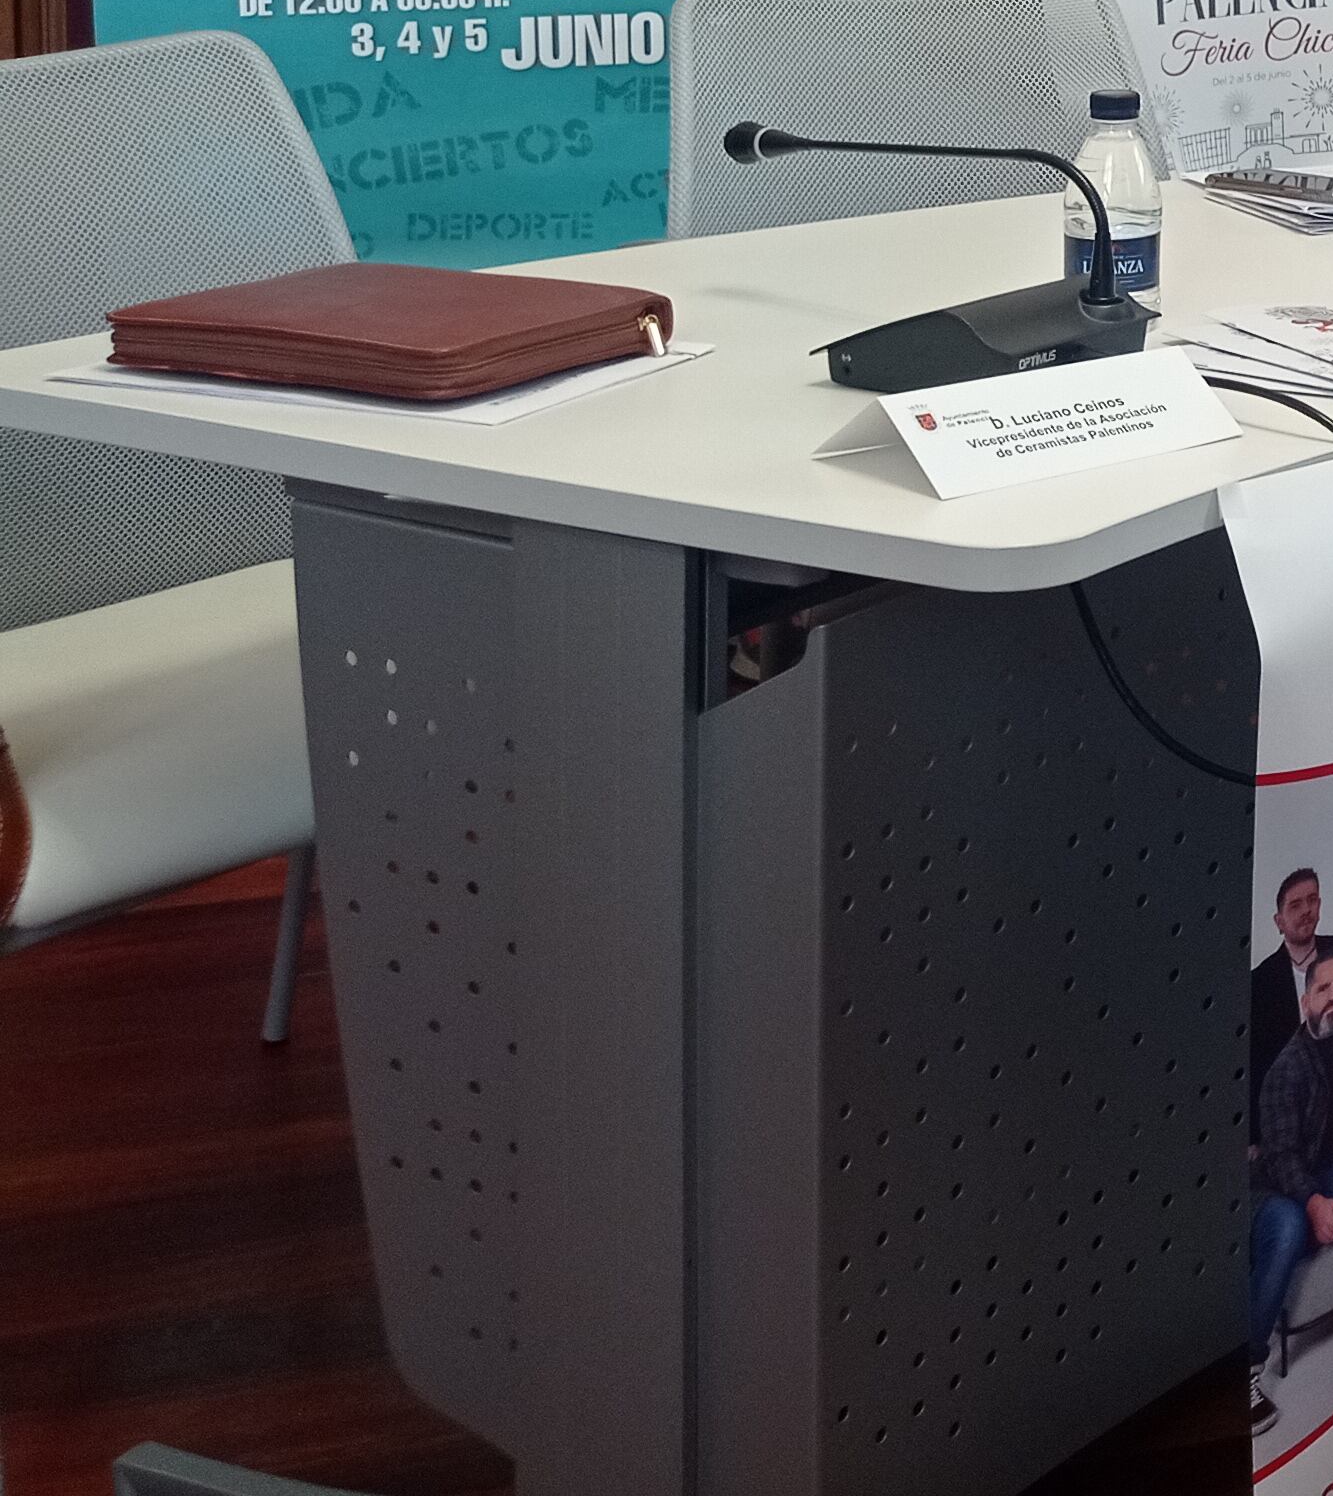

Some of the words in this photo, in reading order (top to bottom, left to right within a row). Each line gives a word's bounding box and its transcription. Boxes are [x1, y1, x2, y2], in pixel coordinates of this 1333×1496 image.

[351, 22, 386, 62] 3,
[397, 21, 421, 55] 4
[432, 25, 453, 59] y
[464, 18, 488, 53] 5
[501, 12, 666, 71] JUNIO
[1160, 29, 1254, 77] Feria
[1212, 75, 1227, 87] Del
[1228, 74, 1236, 85] 2
[1236, 73, 1246, 84] al
[1246, 72, 1253, 83] 5
[1253, 71, 1267, 81] de
[1268, 69, 1292, 82] junio
[1018, 349, 1057, 370] OPTIMUS
[966, 422, 1065, 450] Vicepresidente
[1066, 419, 1083, 430] de
[1084, 416, 1097, 428] la
[1099, 402, 1167, 424] Asociación
[1013, 405, 1072, 427] Luciano
[1073, 395, 1126, 416] Ceinos
[996, 446, 1013, 459] de
[1014, 432, 1088, 454] Ceramistas
[1089, 418, 1155, 440] Palentinos
